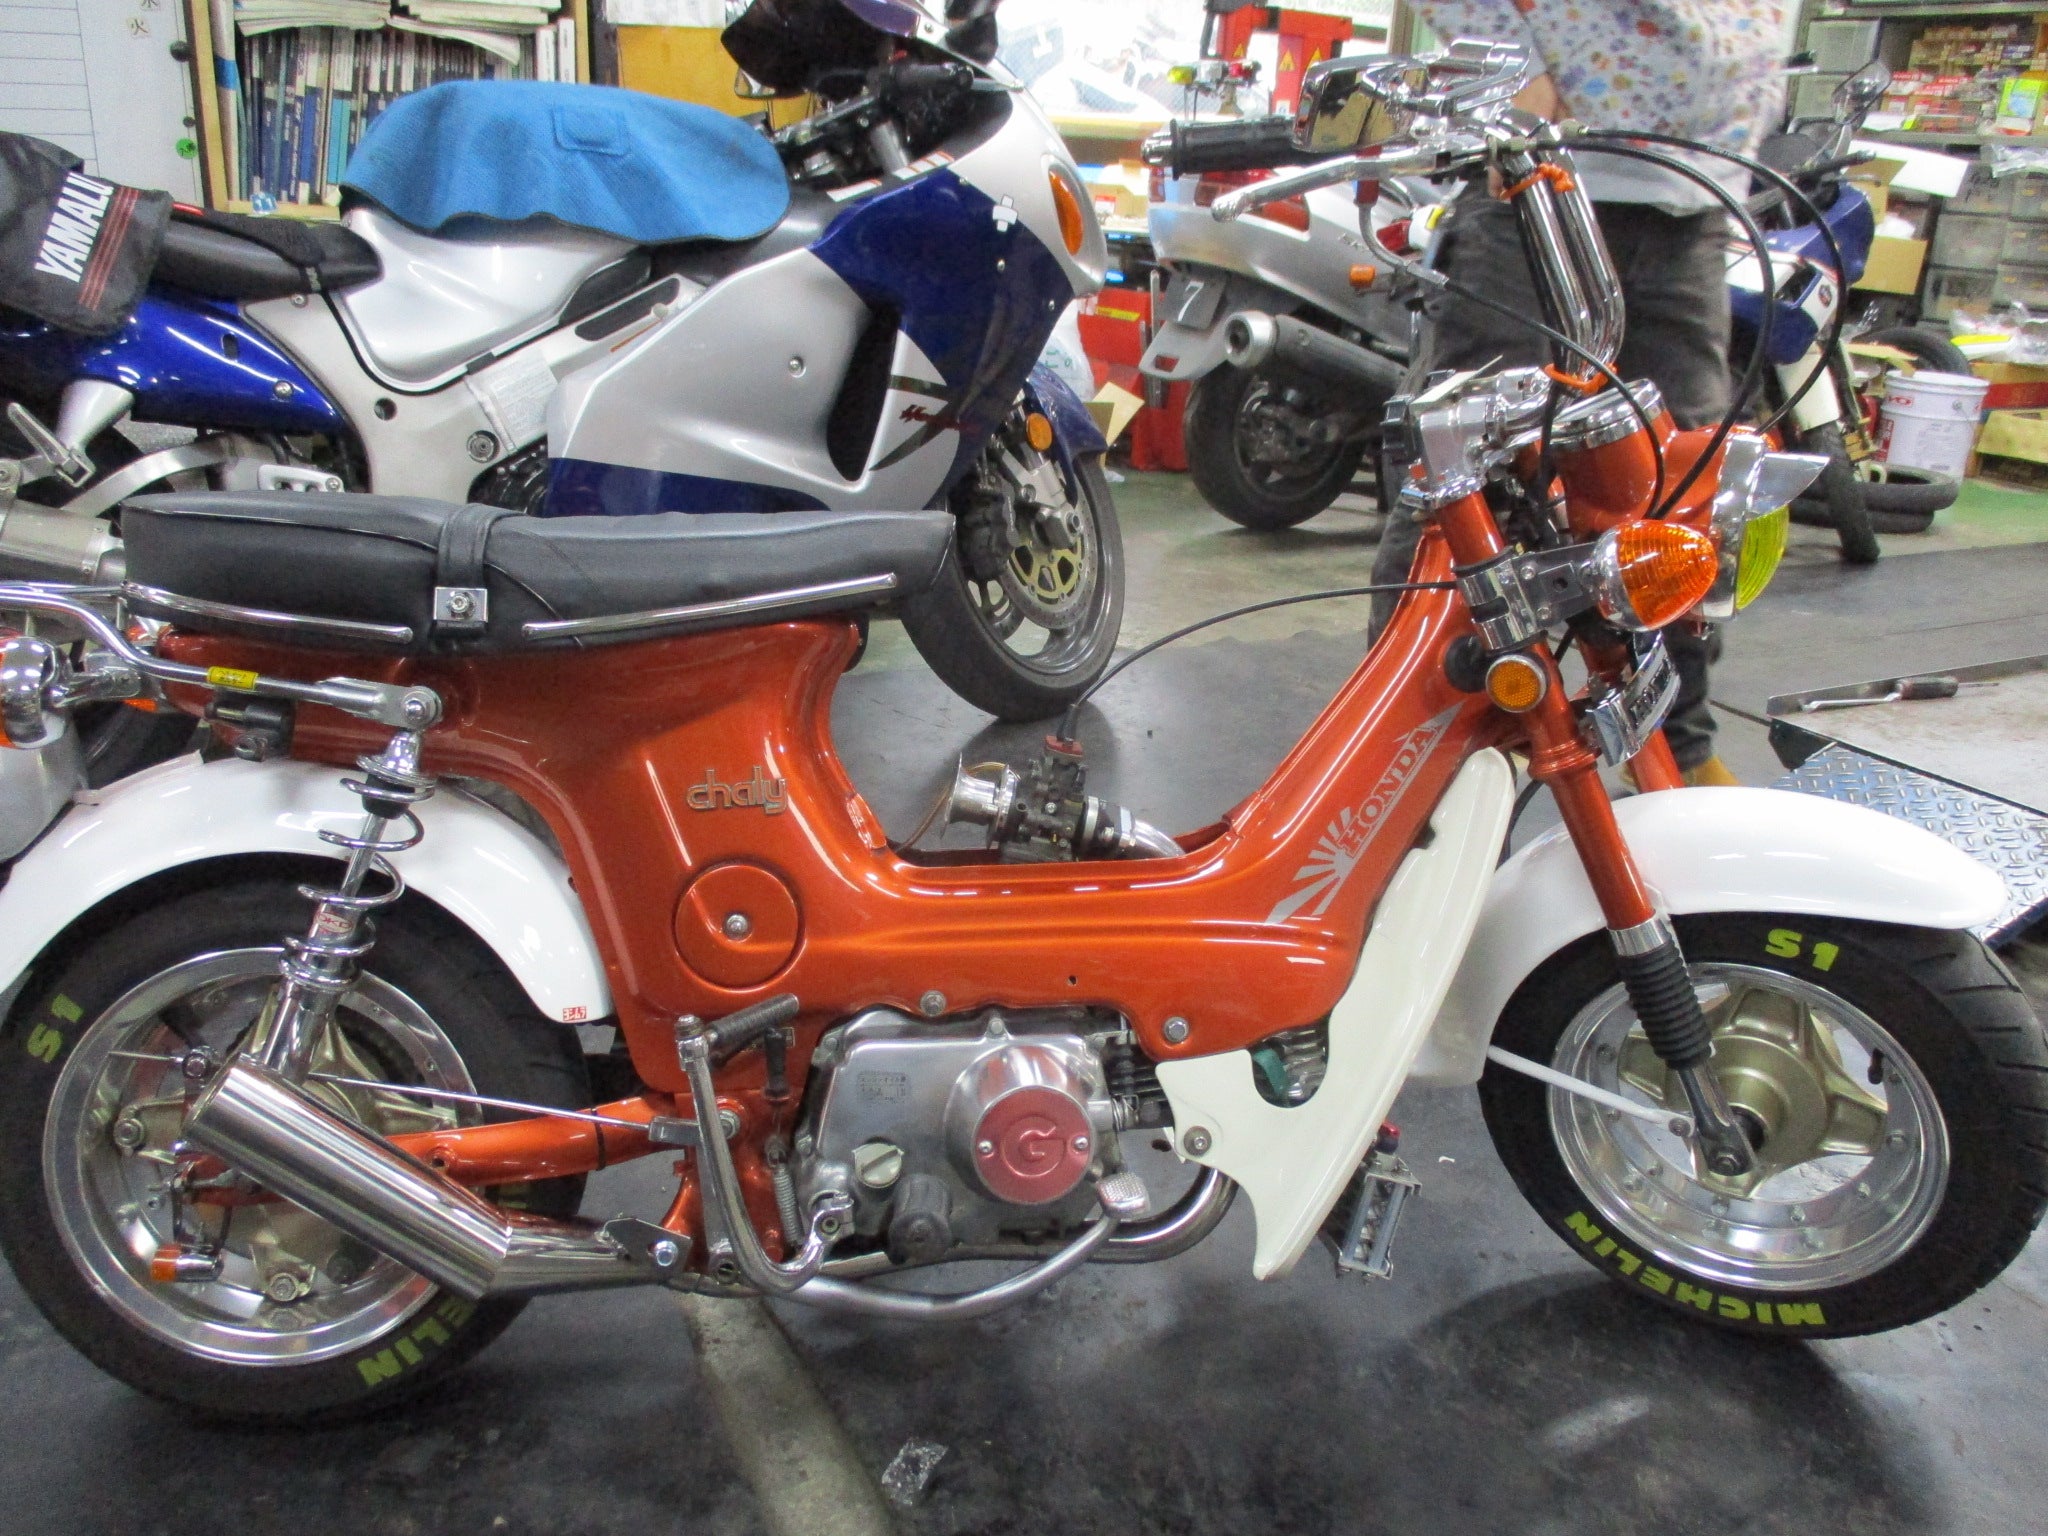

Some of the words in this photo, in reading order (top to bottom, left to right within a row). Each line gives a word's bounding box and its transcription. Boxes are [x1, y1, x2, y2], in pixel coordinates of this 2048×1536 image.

[1177, 280, 1205, 322] 7
[687, 766, 787, 815] chaly
[1337, 727, 1439, 859] HONDA
[1765, 928, 1839, 972] S1
[27, 993, 85, 1064] S1
[562, 1006, 587, 1021] ヨシムラ
[1564, 1211, 1827, 1326] MICHELIN
[357, 1299, 478, 1387] ELIN
